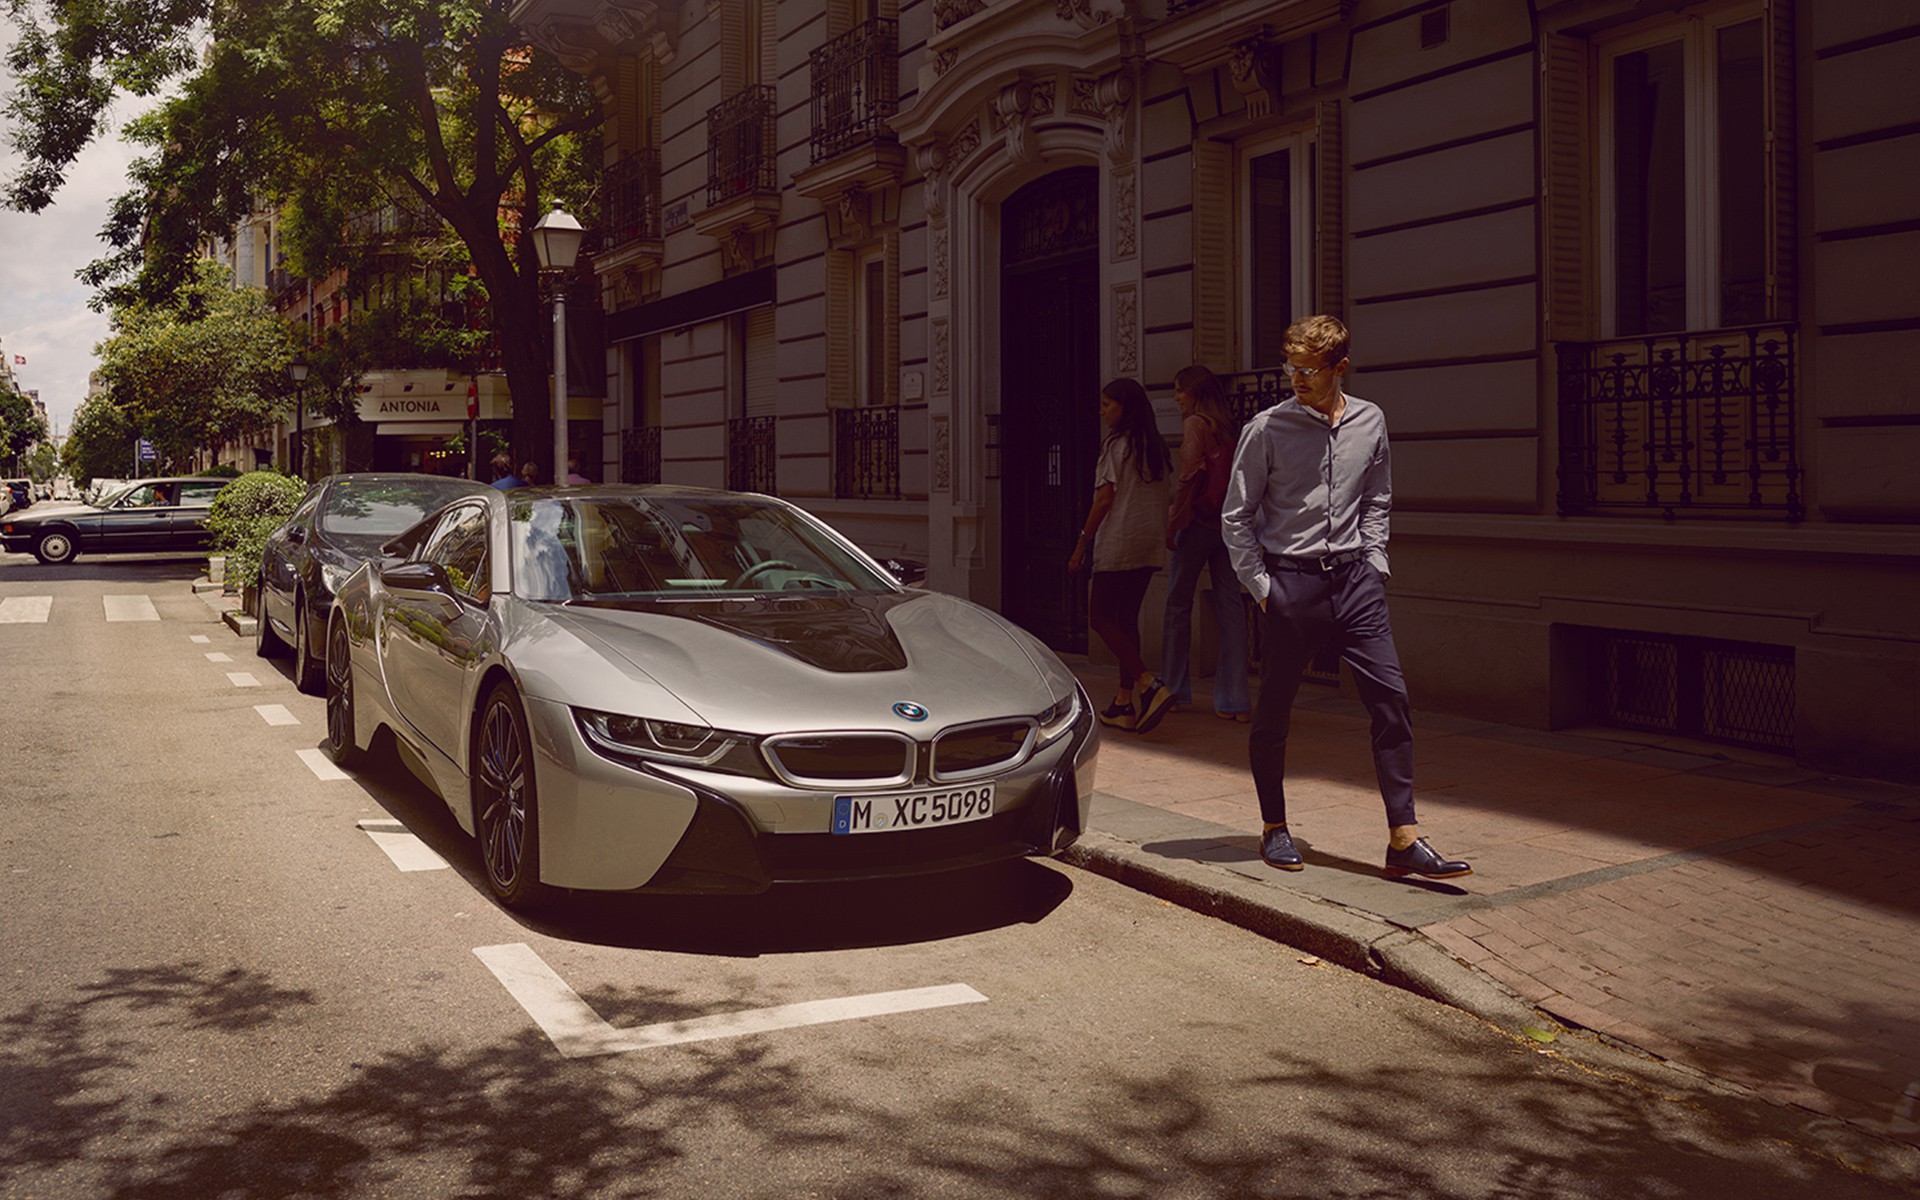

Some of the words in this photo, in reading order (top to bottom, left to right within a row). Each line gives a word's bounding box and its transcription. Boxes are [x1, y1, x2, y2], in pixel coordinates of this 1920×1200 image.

[379, 400, 440, 413] ANTONIA
[852, 800, 872, 829] M
[892, 787, 991, 827] XC5098
[838, 820, 847, 829] D
